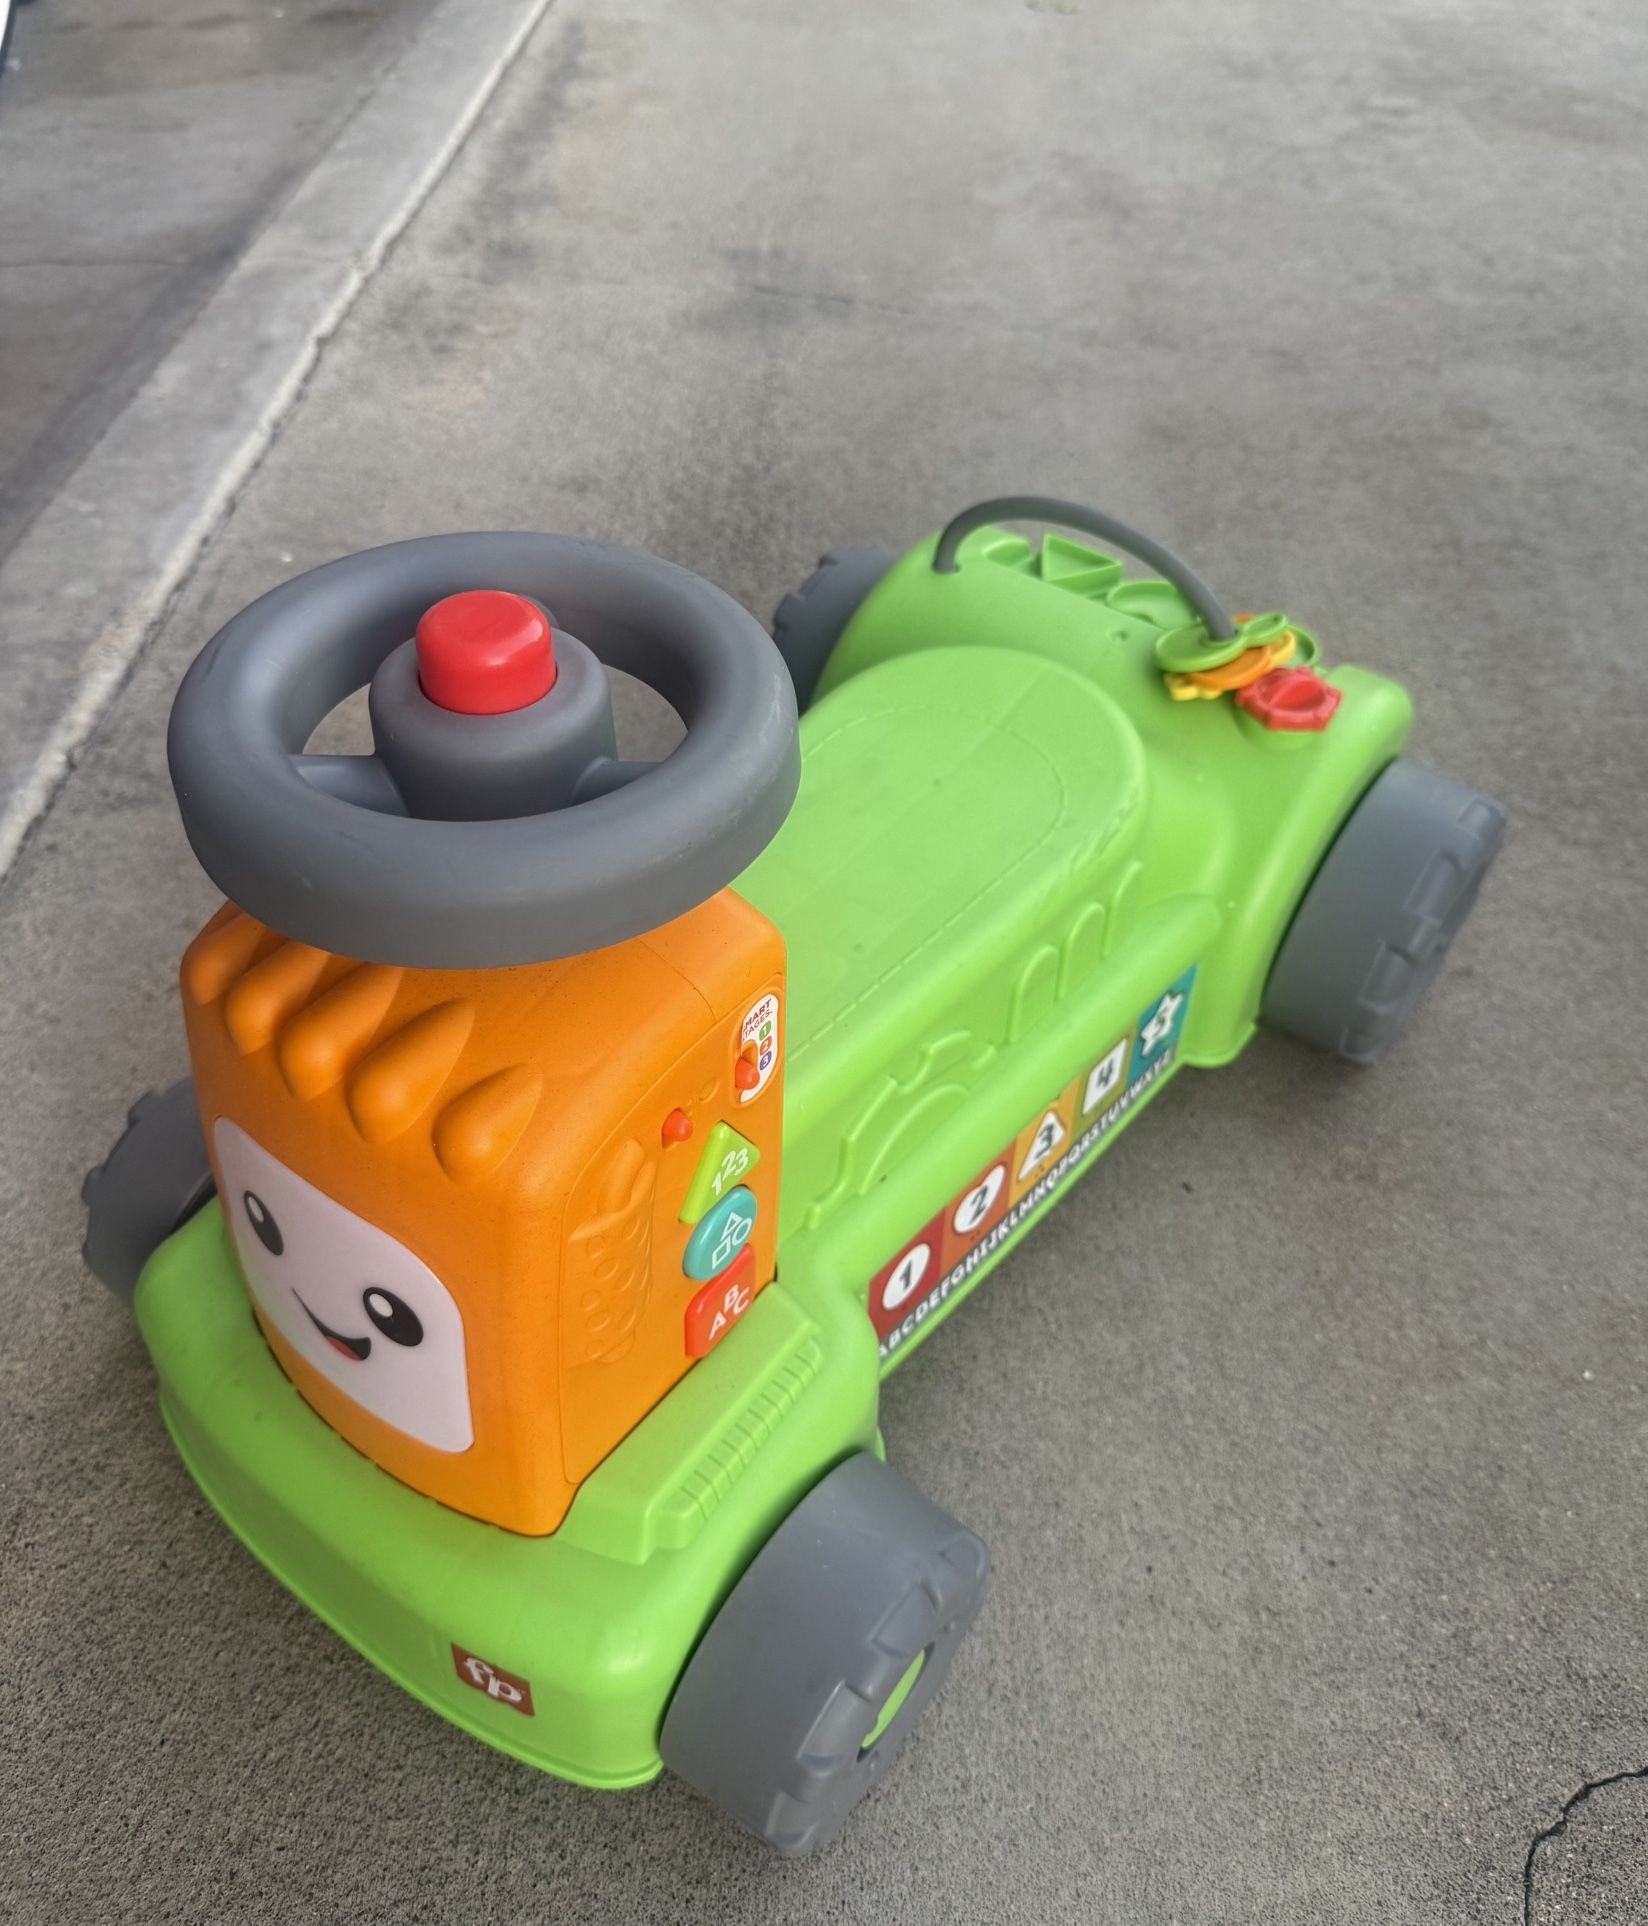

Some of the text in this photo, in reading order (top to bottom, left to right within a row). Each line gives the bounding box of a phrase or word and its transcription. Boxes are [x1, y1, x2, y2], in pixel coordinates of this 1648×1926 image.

[712, 1147, 749, 1196] 123
[900, 1004, 1168, 1291] 1 2 3 4 5
[709, 1284, 750, 1340] ABC
